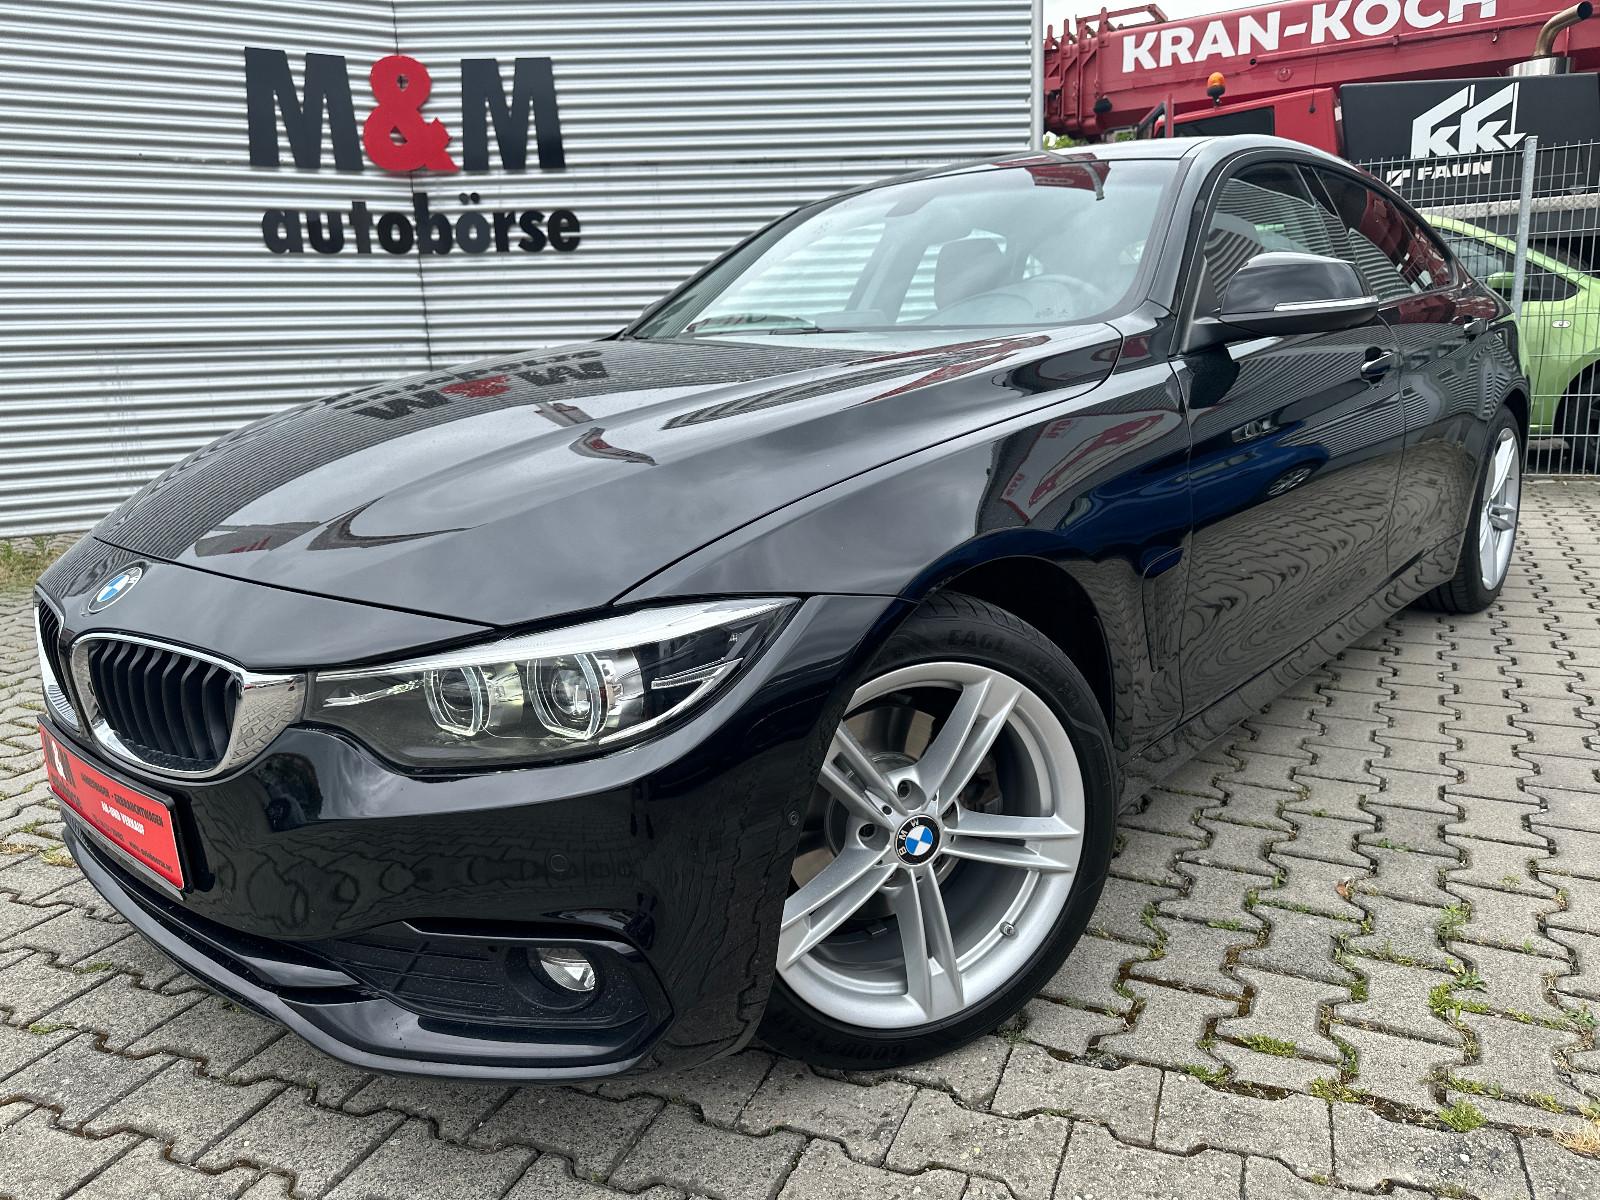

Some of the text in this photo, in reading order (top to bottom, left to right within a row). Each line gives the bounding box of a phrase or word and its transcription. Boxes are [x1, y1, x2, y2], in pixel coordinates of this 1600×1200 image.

[245, 46, 565, 172] M&M
[1417, 161, 1492, 181] FAUN
[262, 192, 580, 254] autobörse
[899, 818, 920, 856] BMW
